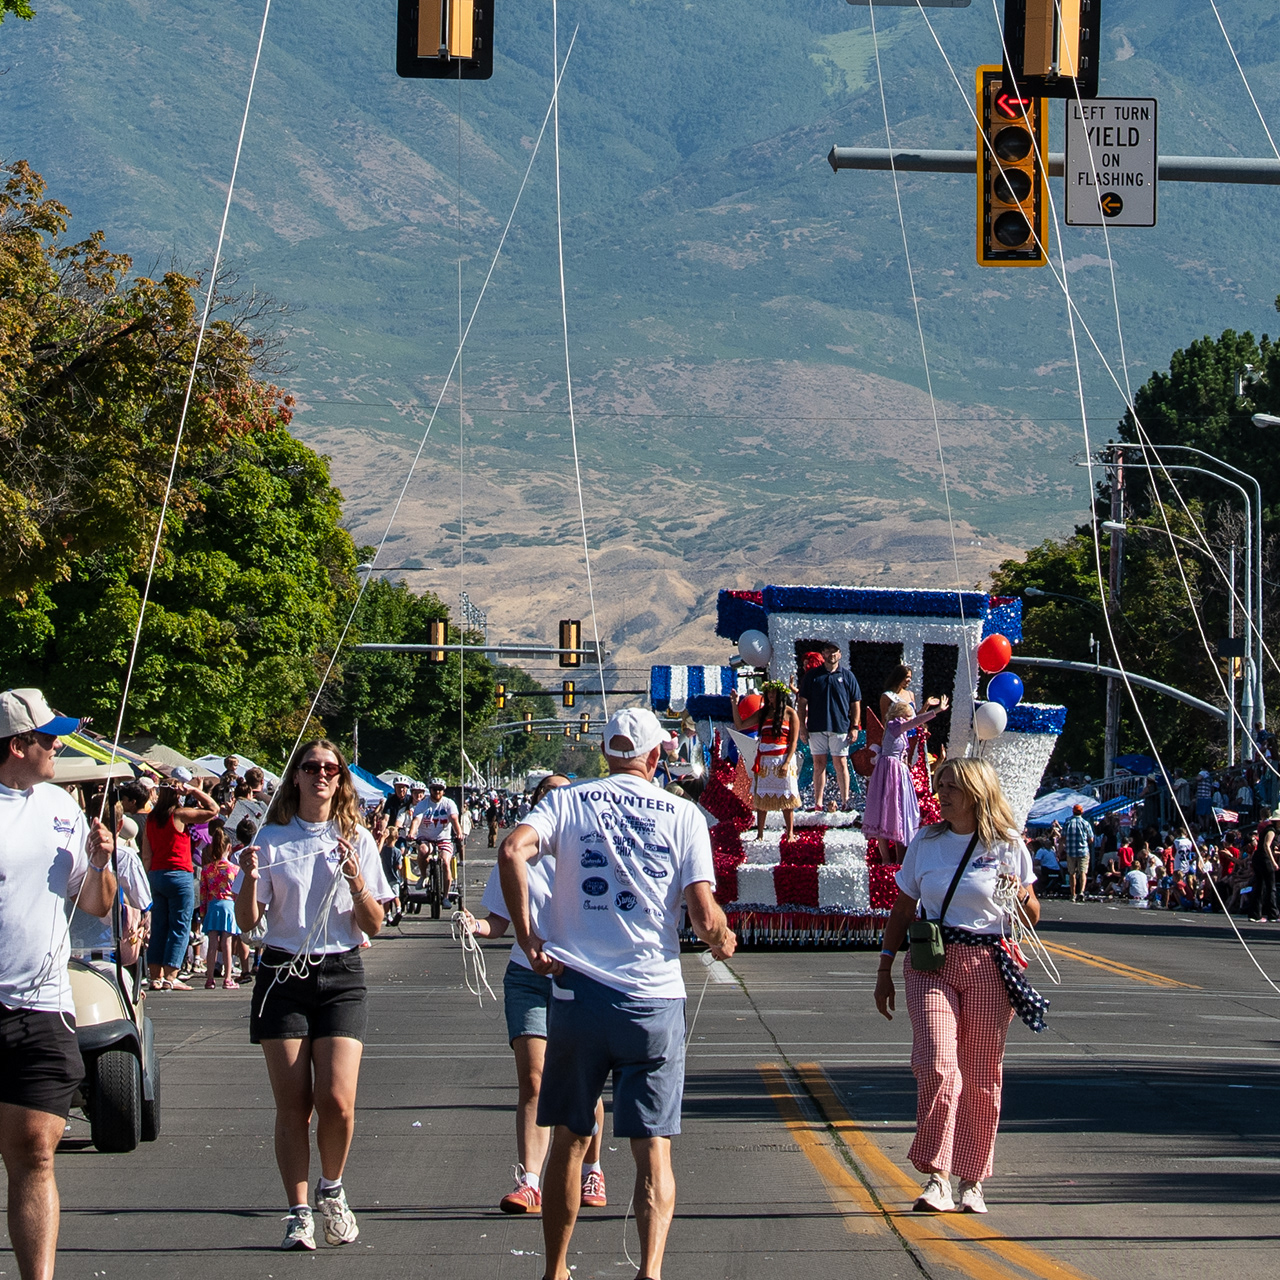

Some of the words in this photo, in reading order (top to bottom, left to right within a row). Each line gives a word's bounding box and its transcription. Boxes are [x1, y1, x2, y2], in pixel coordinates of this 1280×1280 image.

[1074, 106, 1106, 120] LEFT
[1114, 106, 1149, 121] TURN
[1083, 126, 1140, 147] YIELD
[1101, 153, 1120, 168] ON
[1078, 172, 1144, 187] FLASHING
[579, 790, 676, 815] VOLUNTEER
[612, 835, 636, 849] SUPER
[615, 846, 632, 858] CHIX
